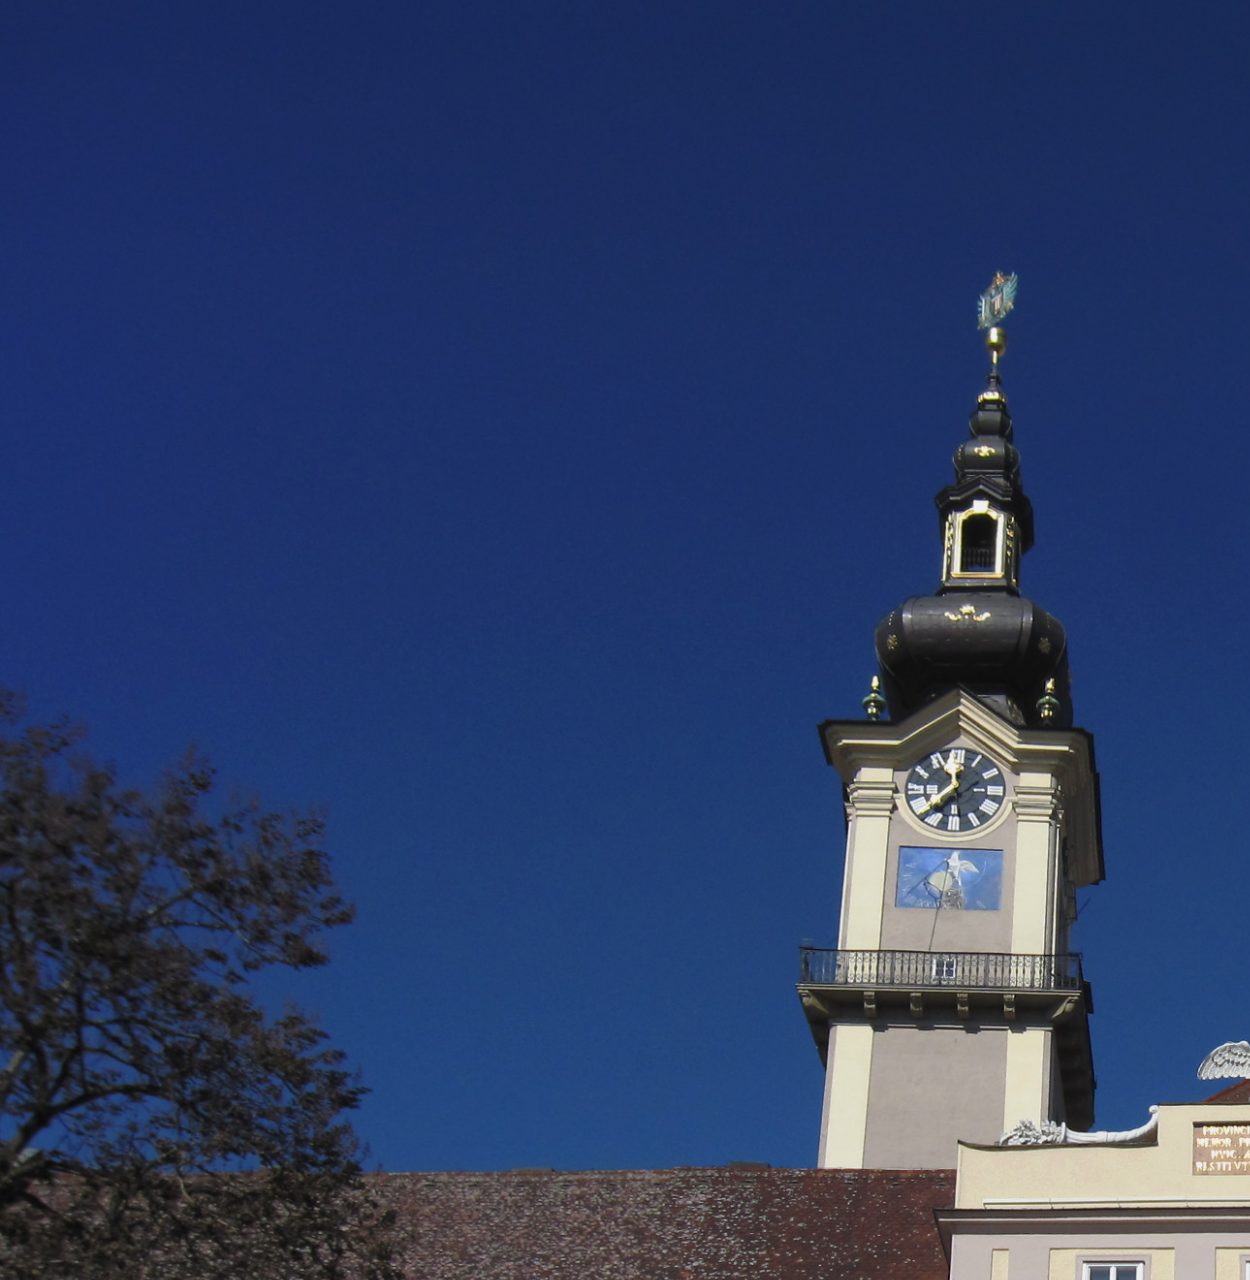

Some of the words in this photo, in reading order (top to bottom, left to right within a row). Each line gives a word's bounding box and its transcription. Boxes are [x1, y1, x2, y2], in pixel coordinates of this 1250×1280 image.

[971, 754, 982, 767] I
[982, 767, 999, 780] II
[987, 785, 1004, 796] III
